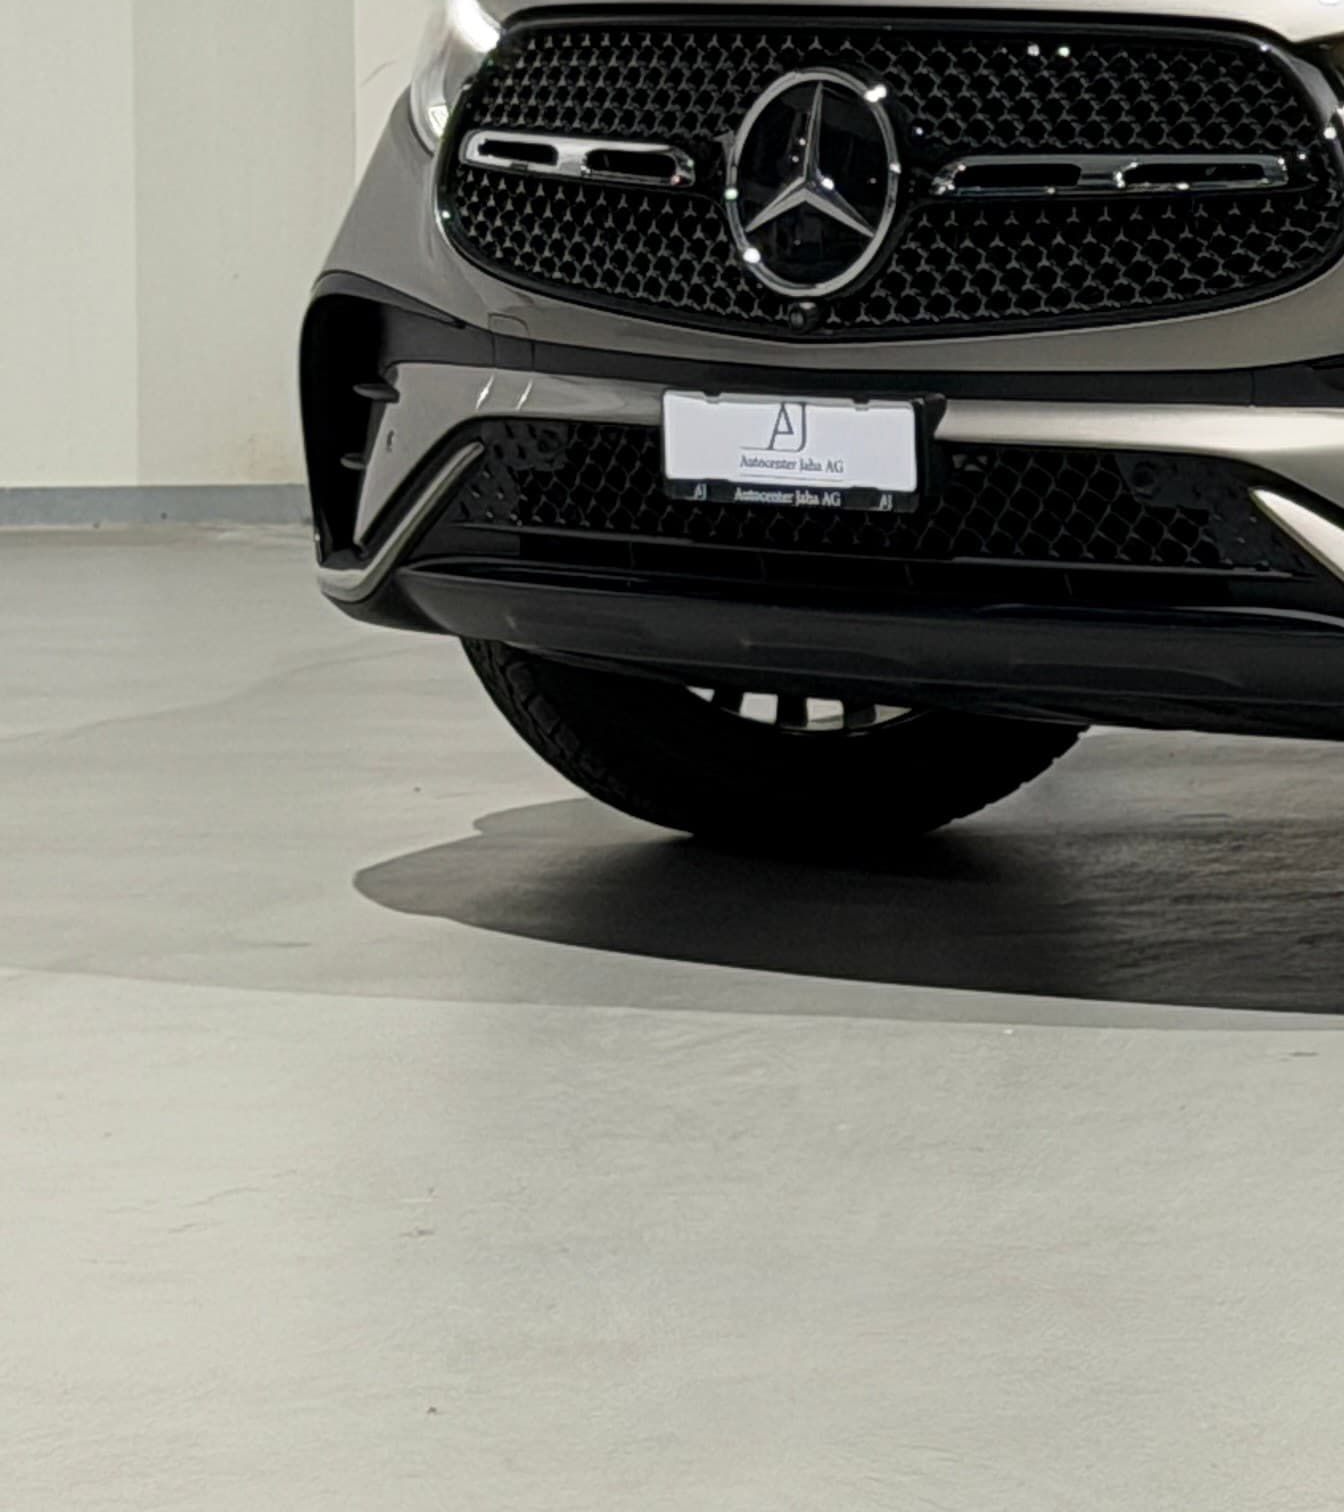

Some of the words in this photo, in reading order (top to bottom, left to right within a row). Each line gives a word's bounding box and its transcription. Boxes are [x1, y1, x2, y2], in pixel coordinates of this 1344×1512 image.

[766, 401, 808, 453] AJ
[740, 454, 797, 470] Autocenter
[799, 457, 823, 472] Jaha
[825, 458, 844, 474] AG
[734, 486, 794, 504] Autocenter
[794, 489, 820, 507] Jaha
[822, 491, 841, 507] AG
